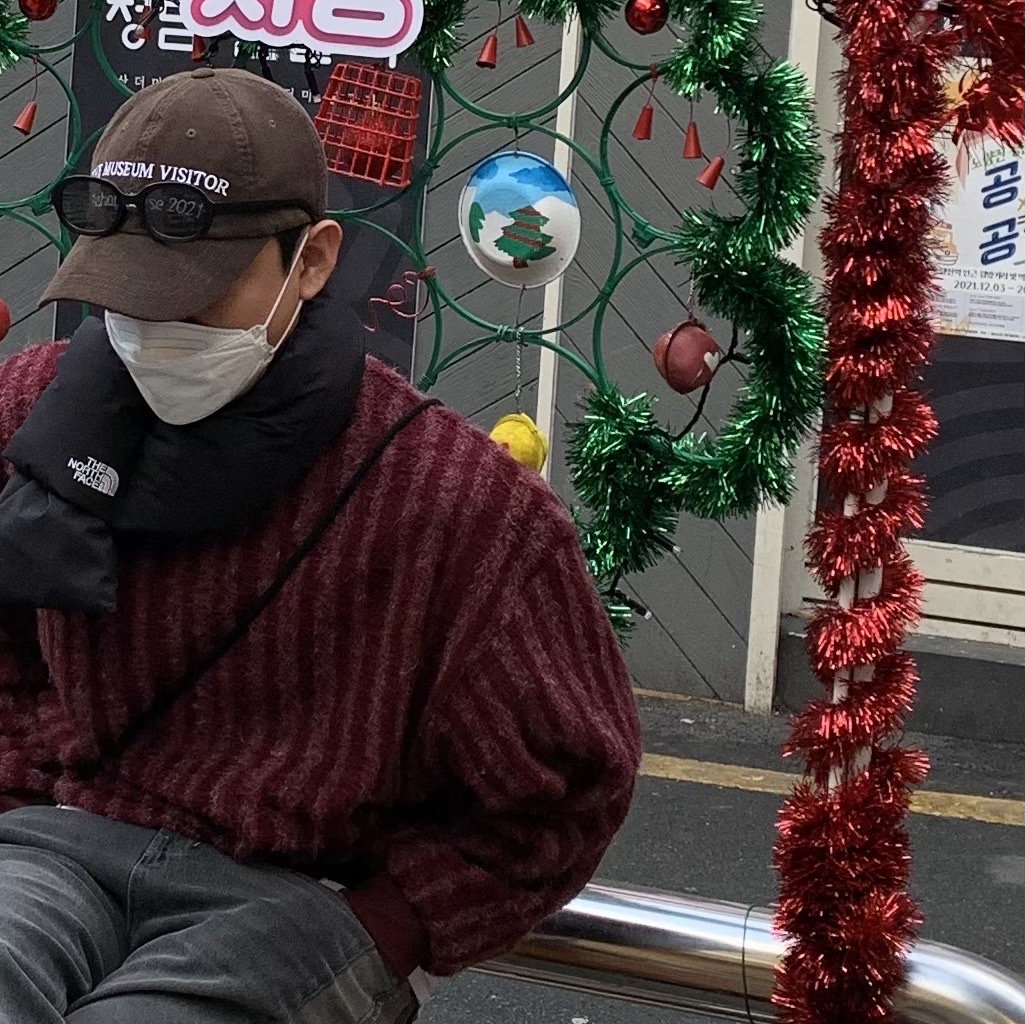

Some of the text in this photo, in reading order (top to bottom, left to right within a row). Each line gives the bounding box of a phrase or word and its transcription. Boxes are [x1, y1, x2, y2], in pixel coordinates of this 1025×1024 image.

[102, 160, 156, 179] MUSEUM
[159, 164, 230, 197] VISITOR
[67, 457, 104, 483] NORTH
[87, 456, 108, 473] THE
[73, 470, 102, 491] FACE
